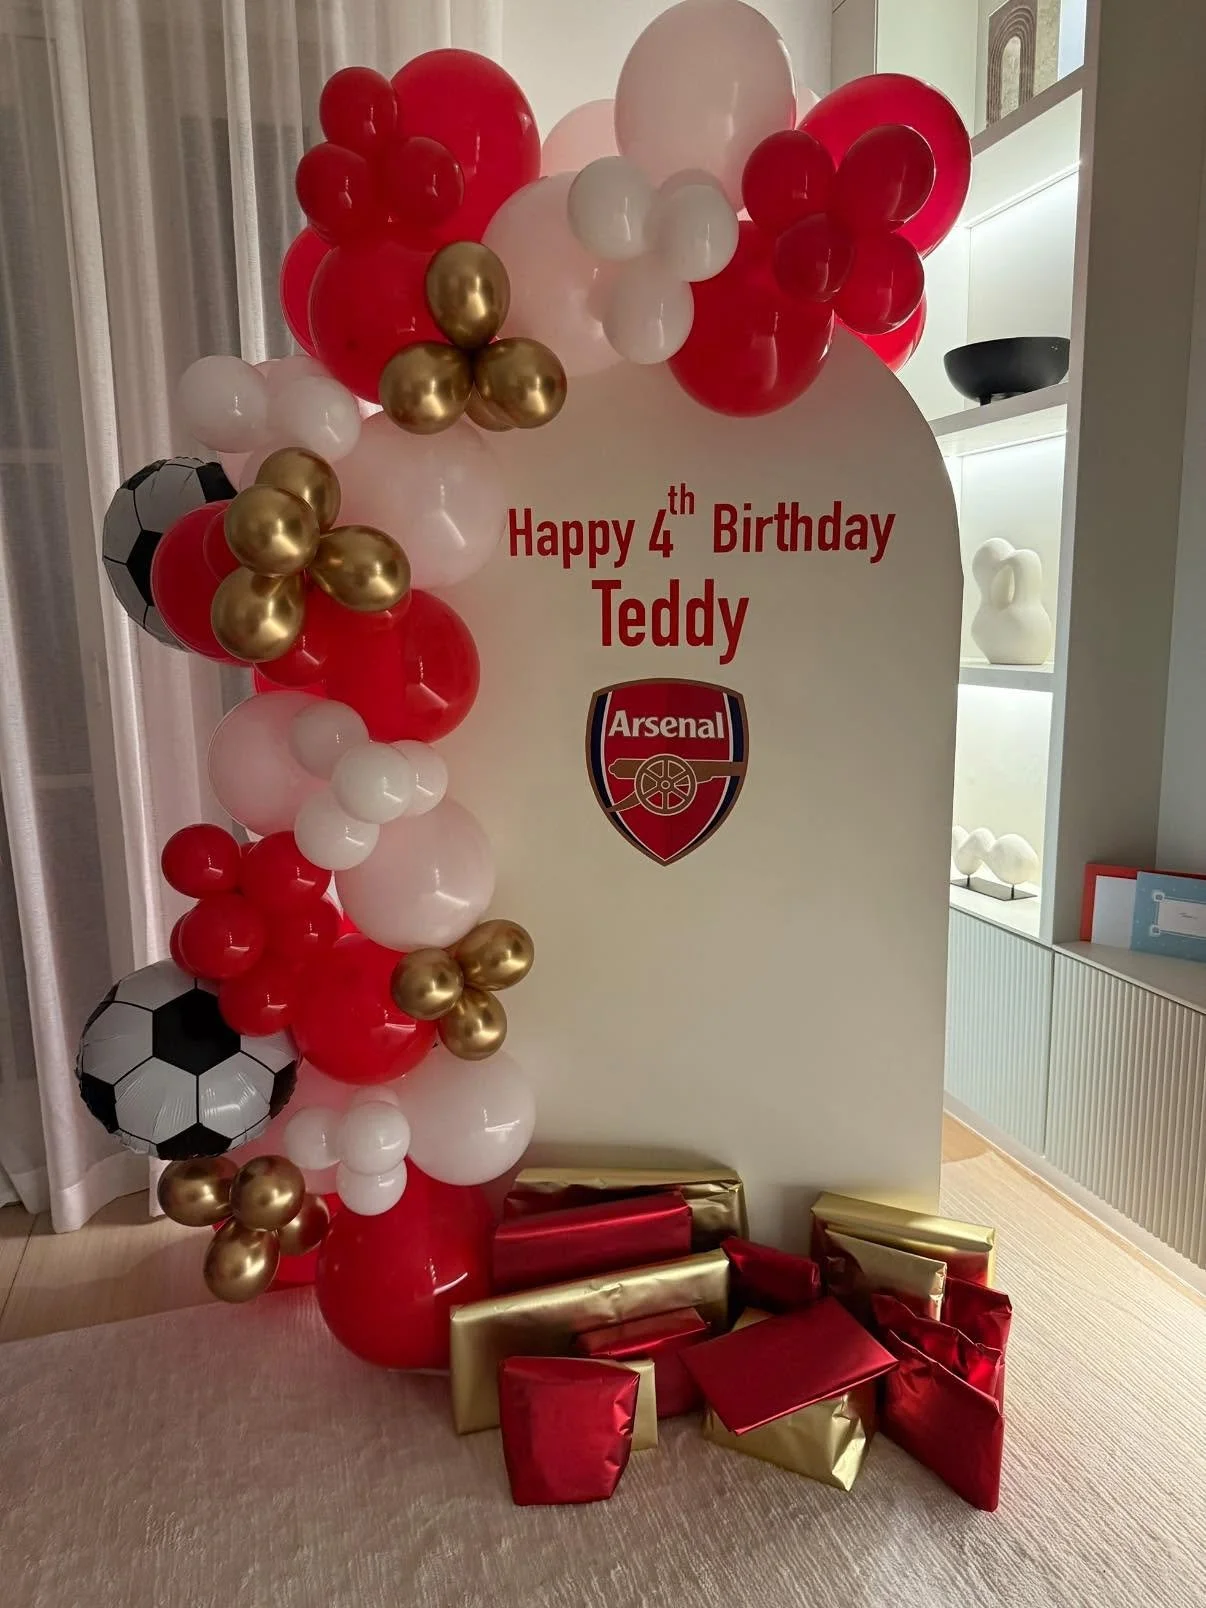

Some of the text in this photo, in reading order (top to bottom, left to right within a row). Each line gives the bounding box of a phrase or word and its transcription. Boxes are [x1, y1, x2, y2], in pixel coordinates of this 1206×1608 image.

[508, 483, 896, 569] Happy 4th Birthday
[592, 579, 749, 665] Teddy
[608, 710, 725, 739] Arsenal
